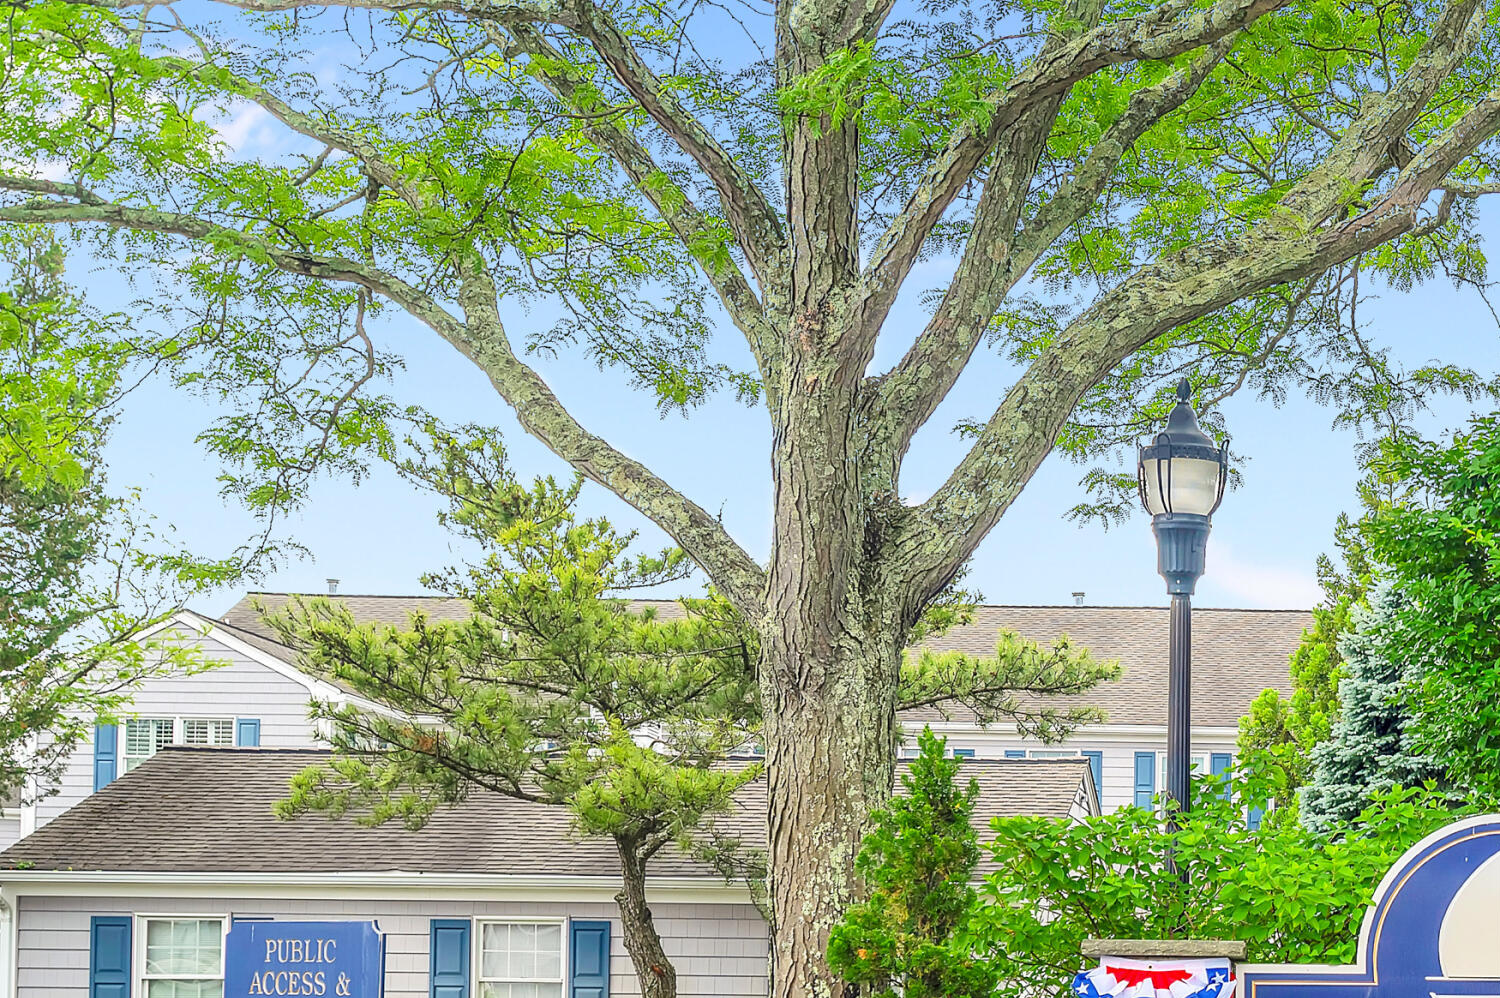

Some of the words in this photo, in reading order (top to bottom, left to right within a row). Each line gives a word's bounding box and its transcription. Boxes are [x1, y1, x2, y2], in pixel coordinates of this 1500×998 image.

[264, 938, 337, 964] PUBLIC
[248, 971, 326, 996] ACCESS
[335, 971, 351, 997] &
